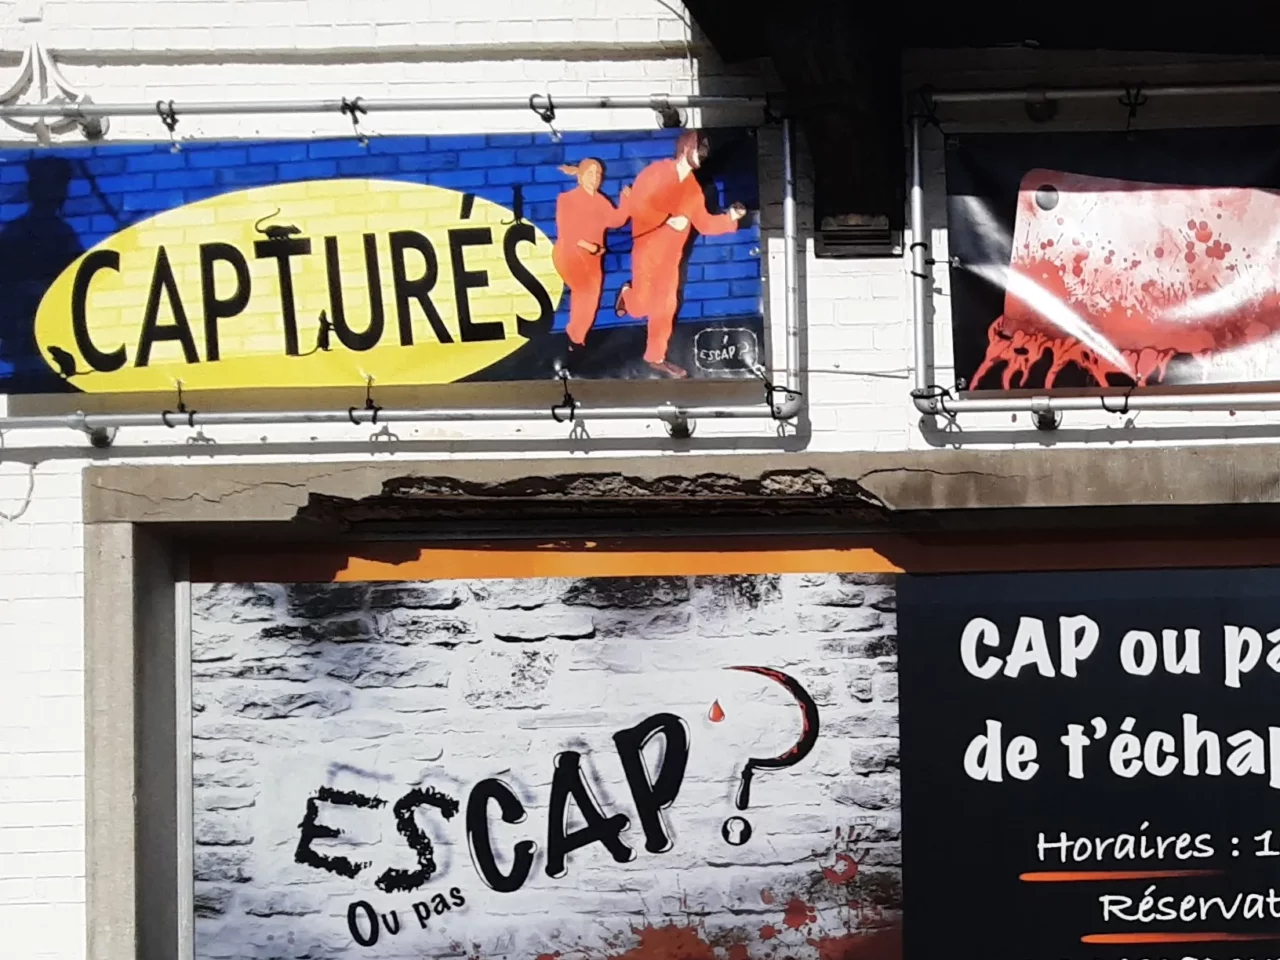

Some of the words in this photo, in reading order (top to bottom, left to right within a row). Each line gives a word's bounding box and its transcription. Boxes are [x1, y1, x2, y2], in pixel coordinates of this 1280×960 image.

[71, 192, 556, 373] CAPTURÉS
[960, 614, 1100, 680] CAP
[1120, 628, 1201, 676] ou
[963, 719, 1040, 783] de
[1037, 821, 1215, 863] Horaires
[347, 900, 401, 946] Ou
[413, 886, 466, 928] pas
